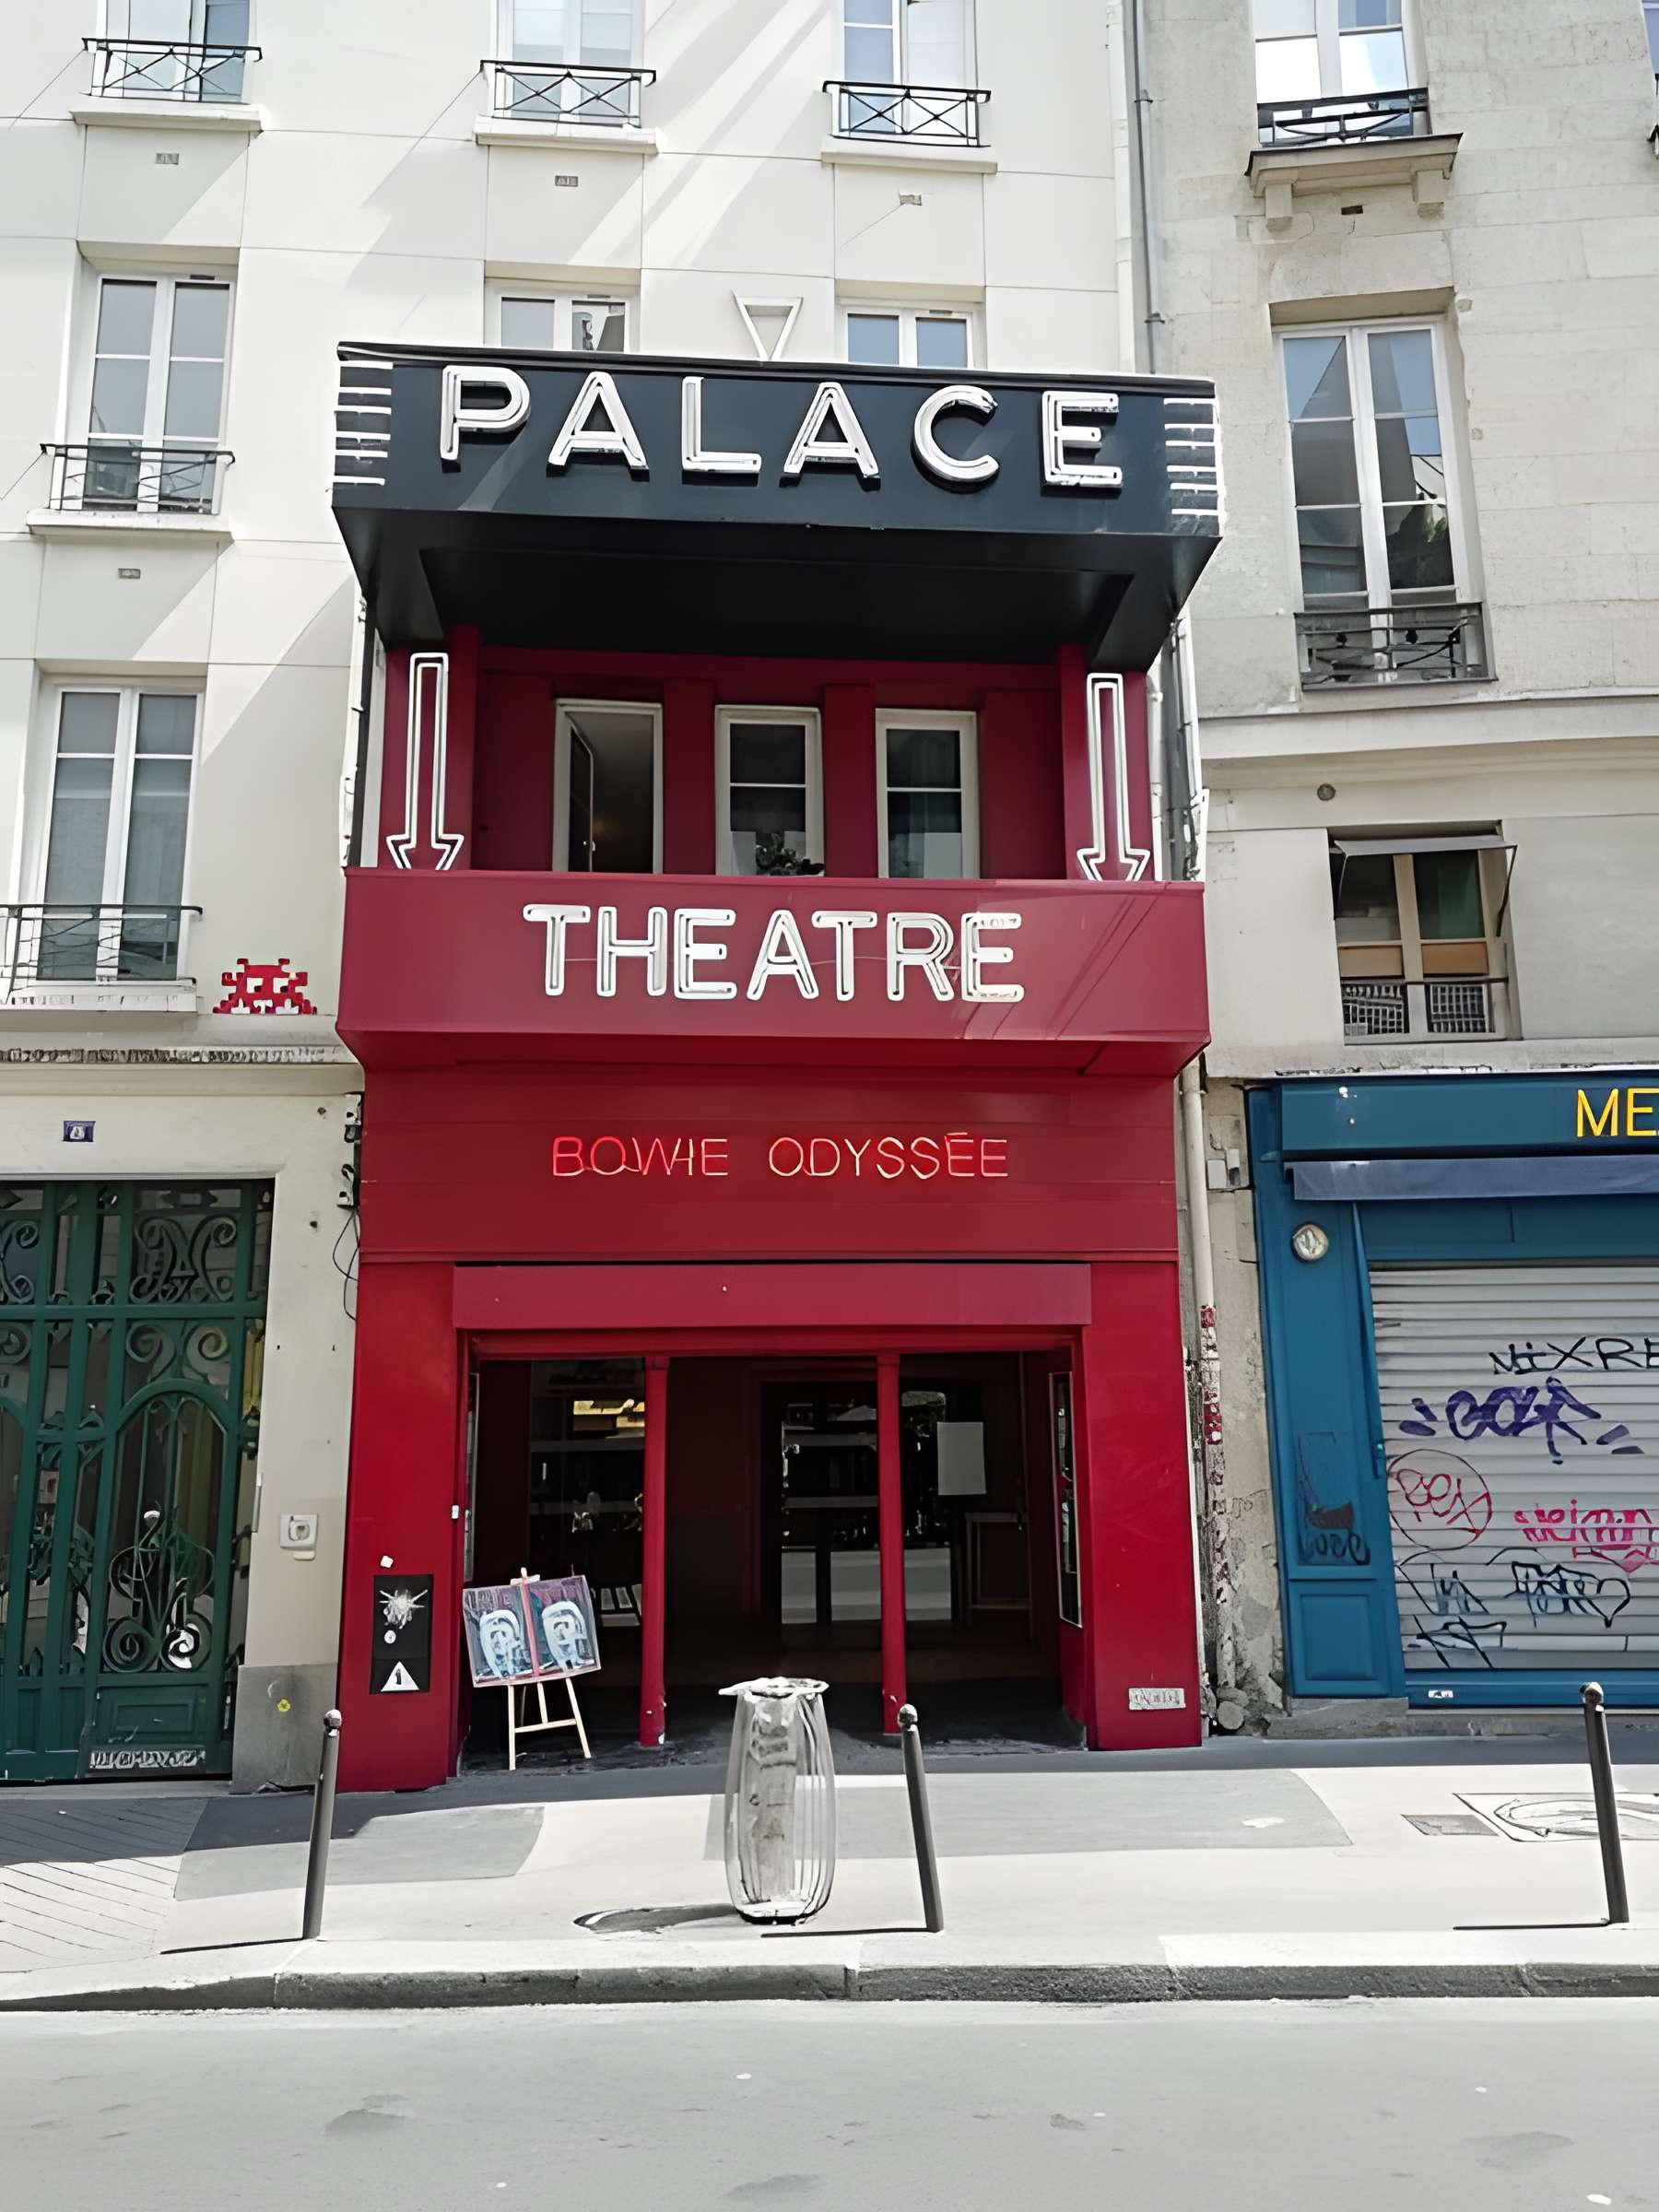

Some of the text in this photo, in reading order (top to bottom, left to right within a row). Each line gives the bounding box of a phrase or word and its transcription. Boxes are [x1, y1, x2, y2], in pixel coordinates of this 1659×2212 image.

[439, 364, 1124, 488] PALACE
[523, 903, 1025, 1003] THEATRE
[1576, 1088, 1659, 1137] ME
[552, 1135, 729, 1176] BOWIE
